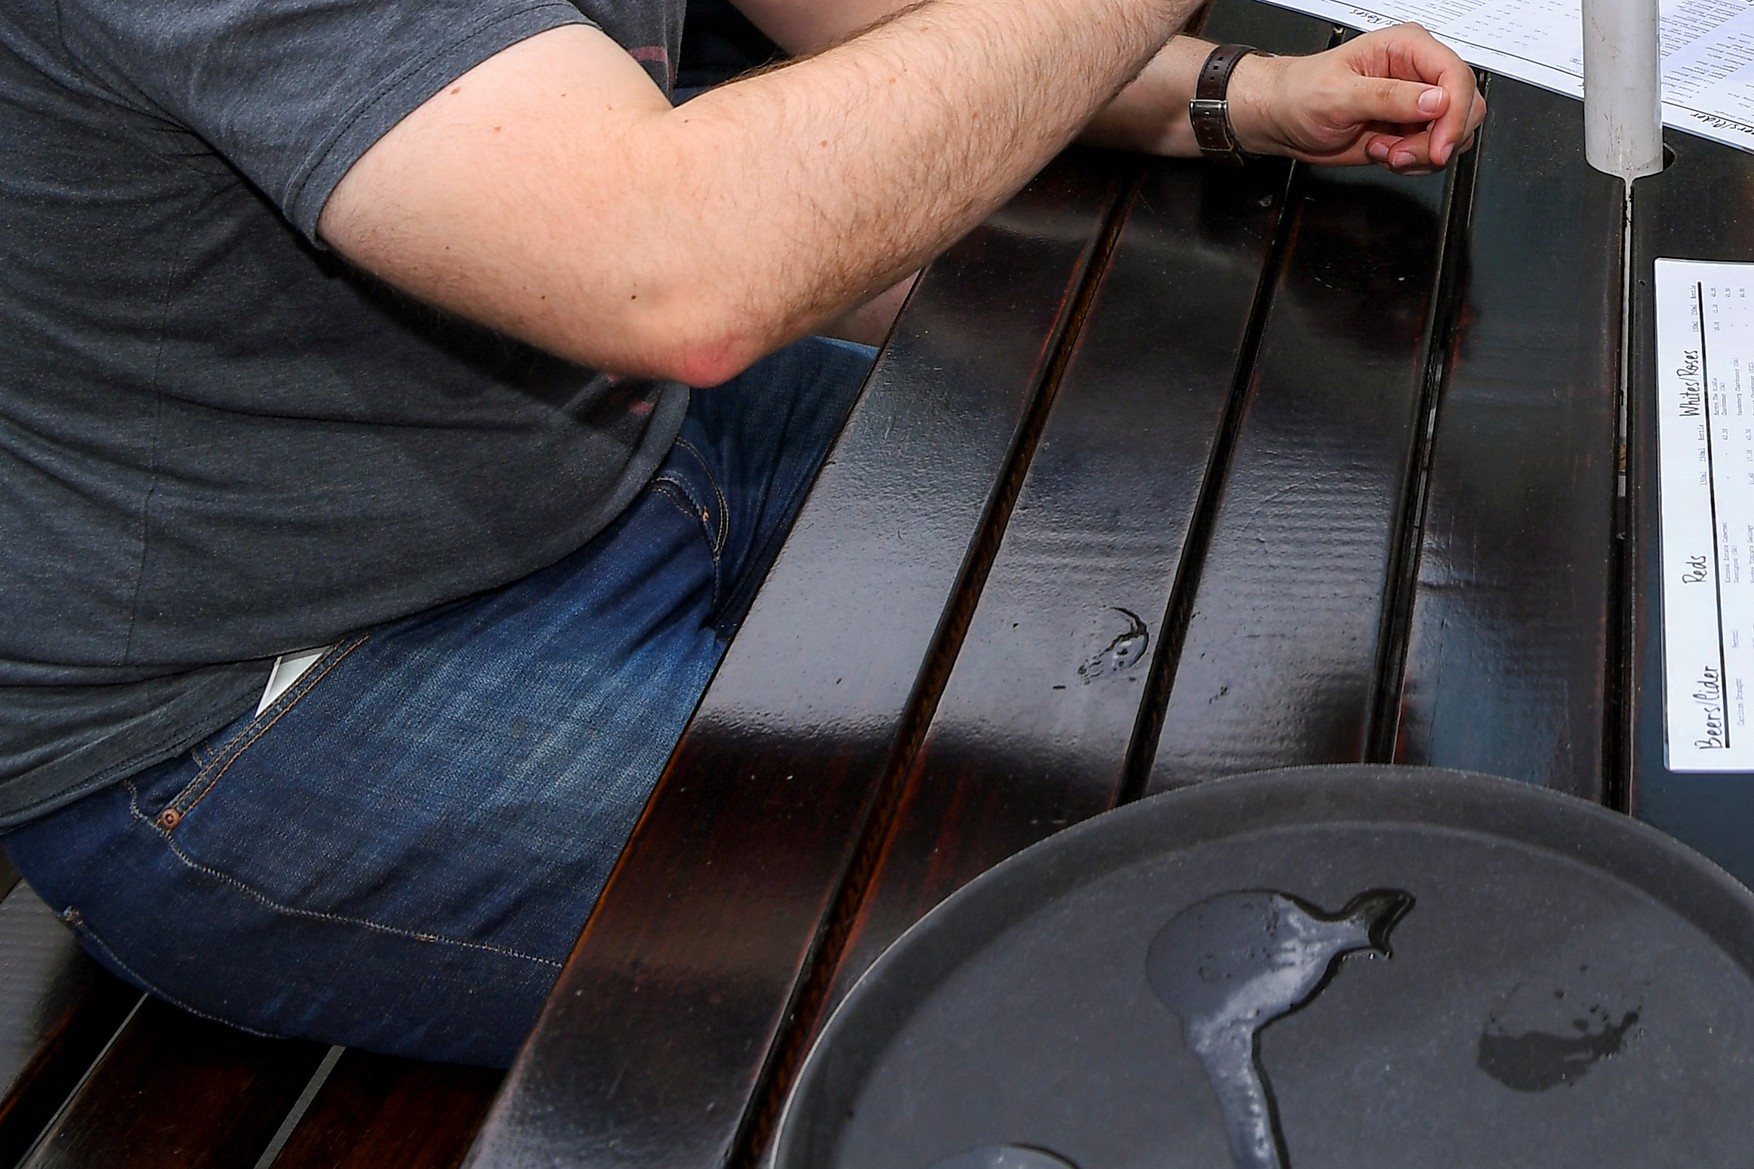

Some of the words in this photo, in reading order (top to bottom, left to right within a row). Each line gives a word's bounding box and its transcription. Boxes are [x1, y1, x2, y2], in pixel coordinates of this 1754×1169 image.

[1676, 350, 1701, 417] Whites/Roses
[1681, 555, 1708, 584] Reds
[1692, 665, 1723, 750] Beers/Cider
